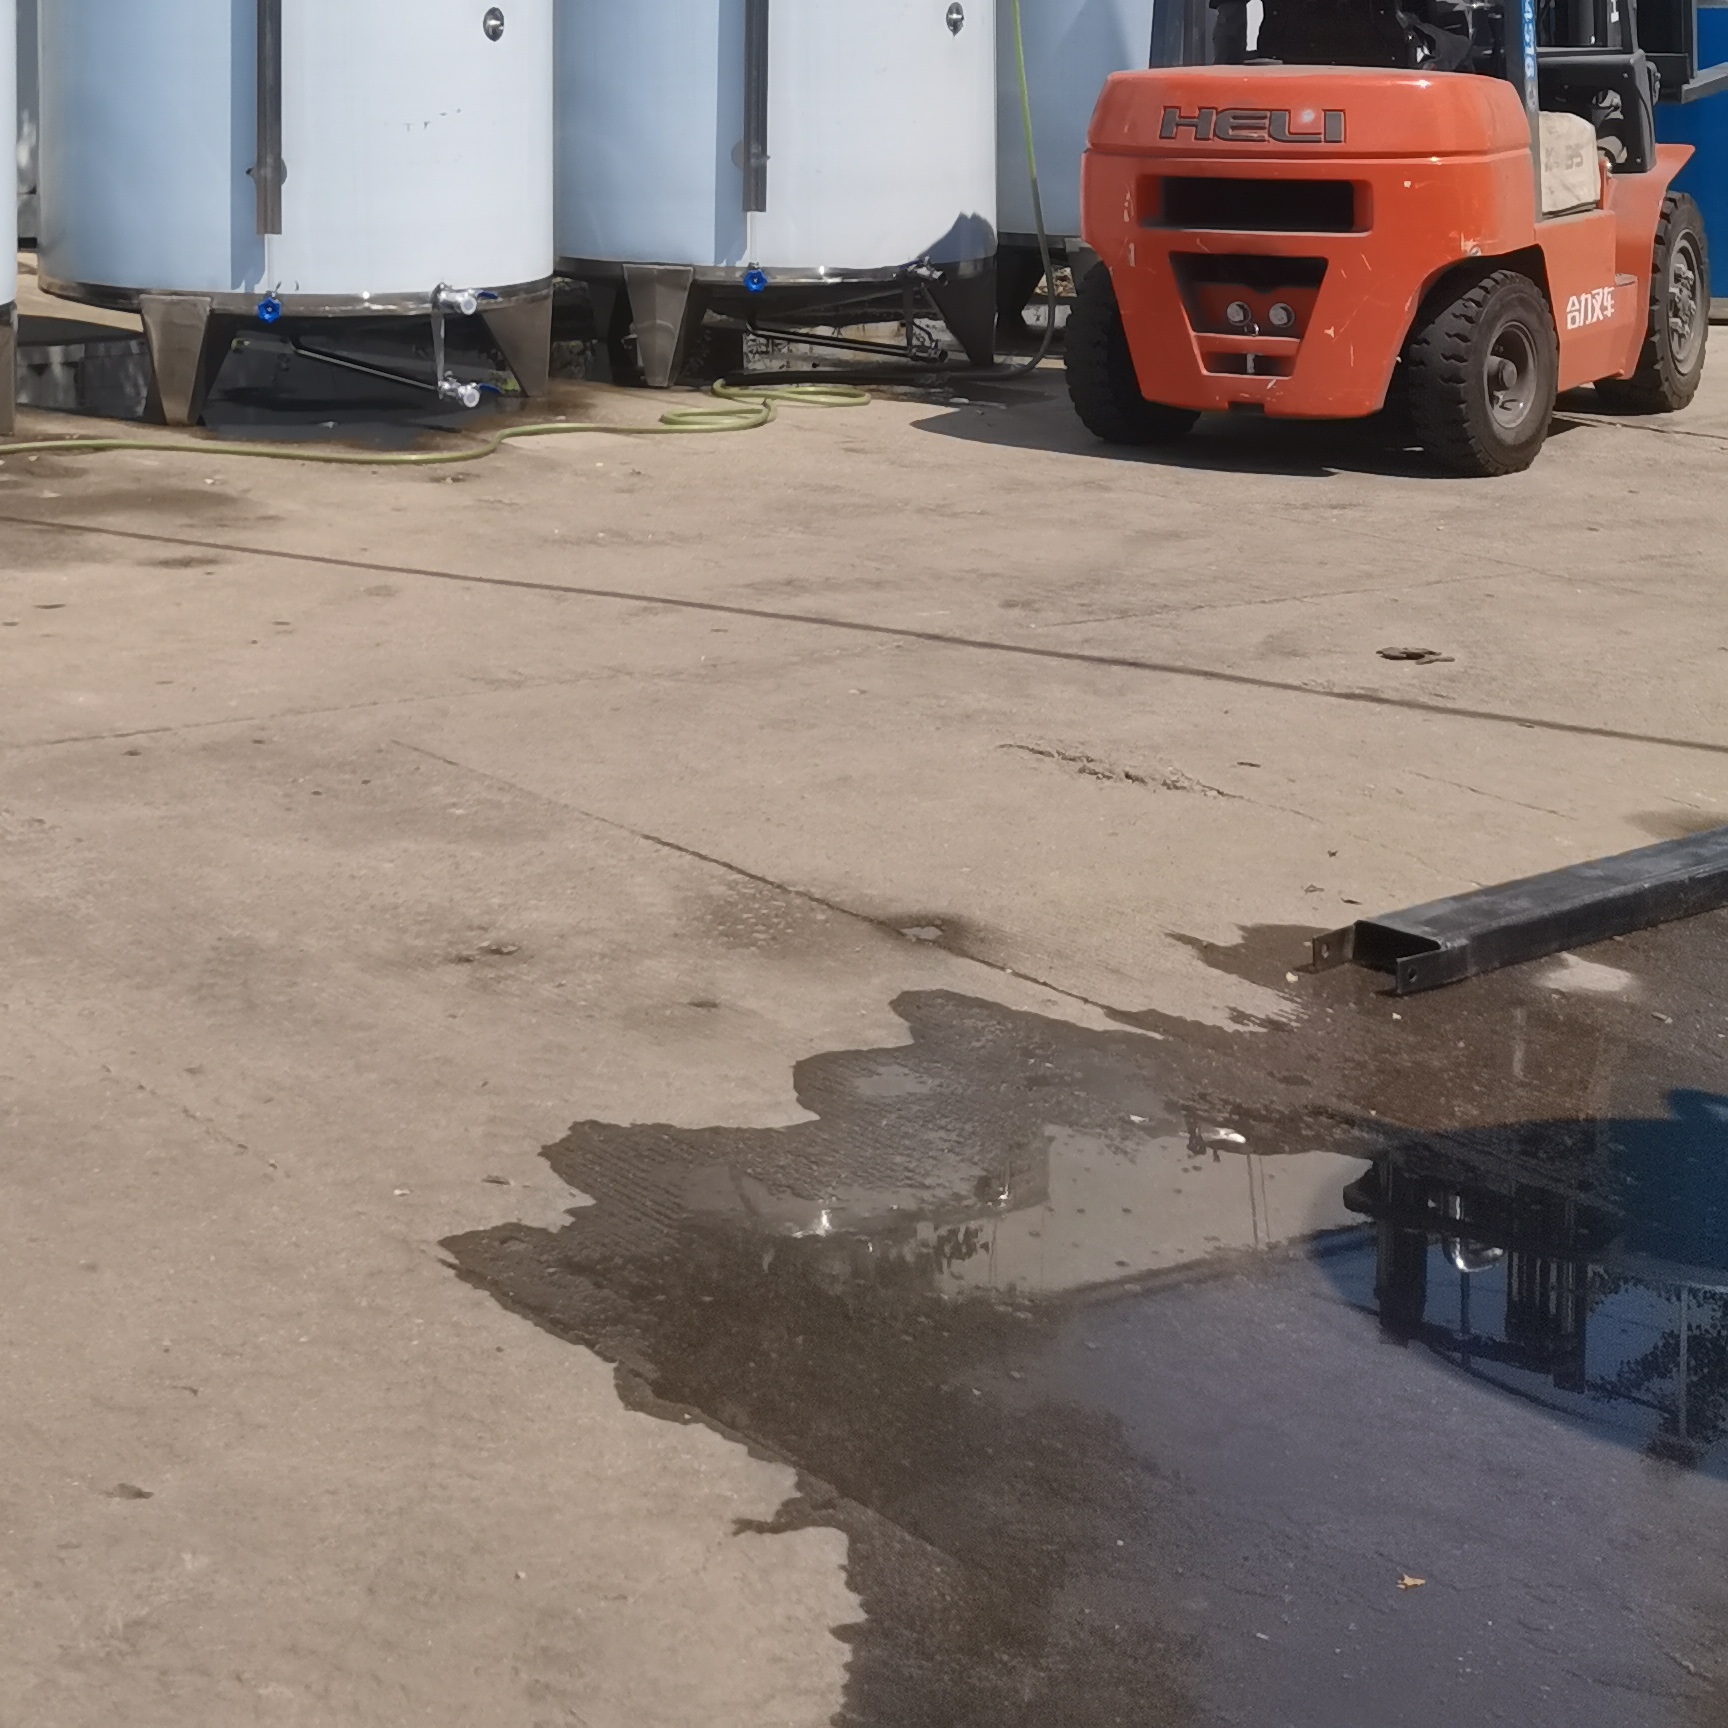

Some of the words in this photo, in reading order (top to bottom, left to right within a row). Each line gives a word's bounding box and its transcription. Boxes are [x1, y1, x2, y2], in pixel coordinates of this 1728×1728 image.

[1159, 106, 1347, 143] HELI
[1566, 287, 1615, 330] 合力叉车
